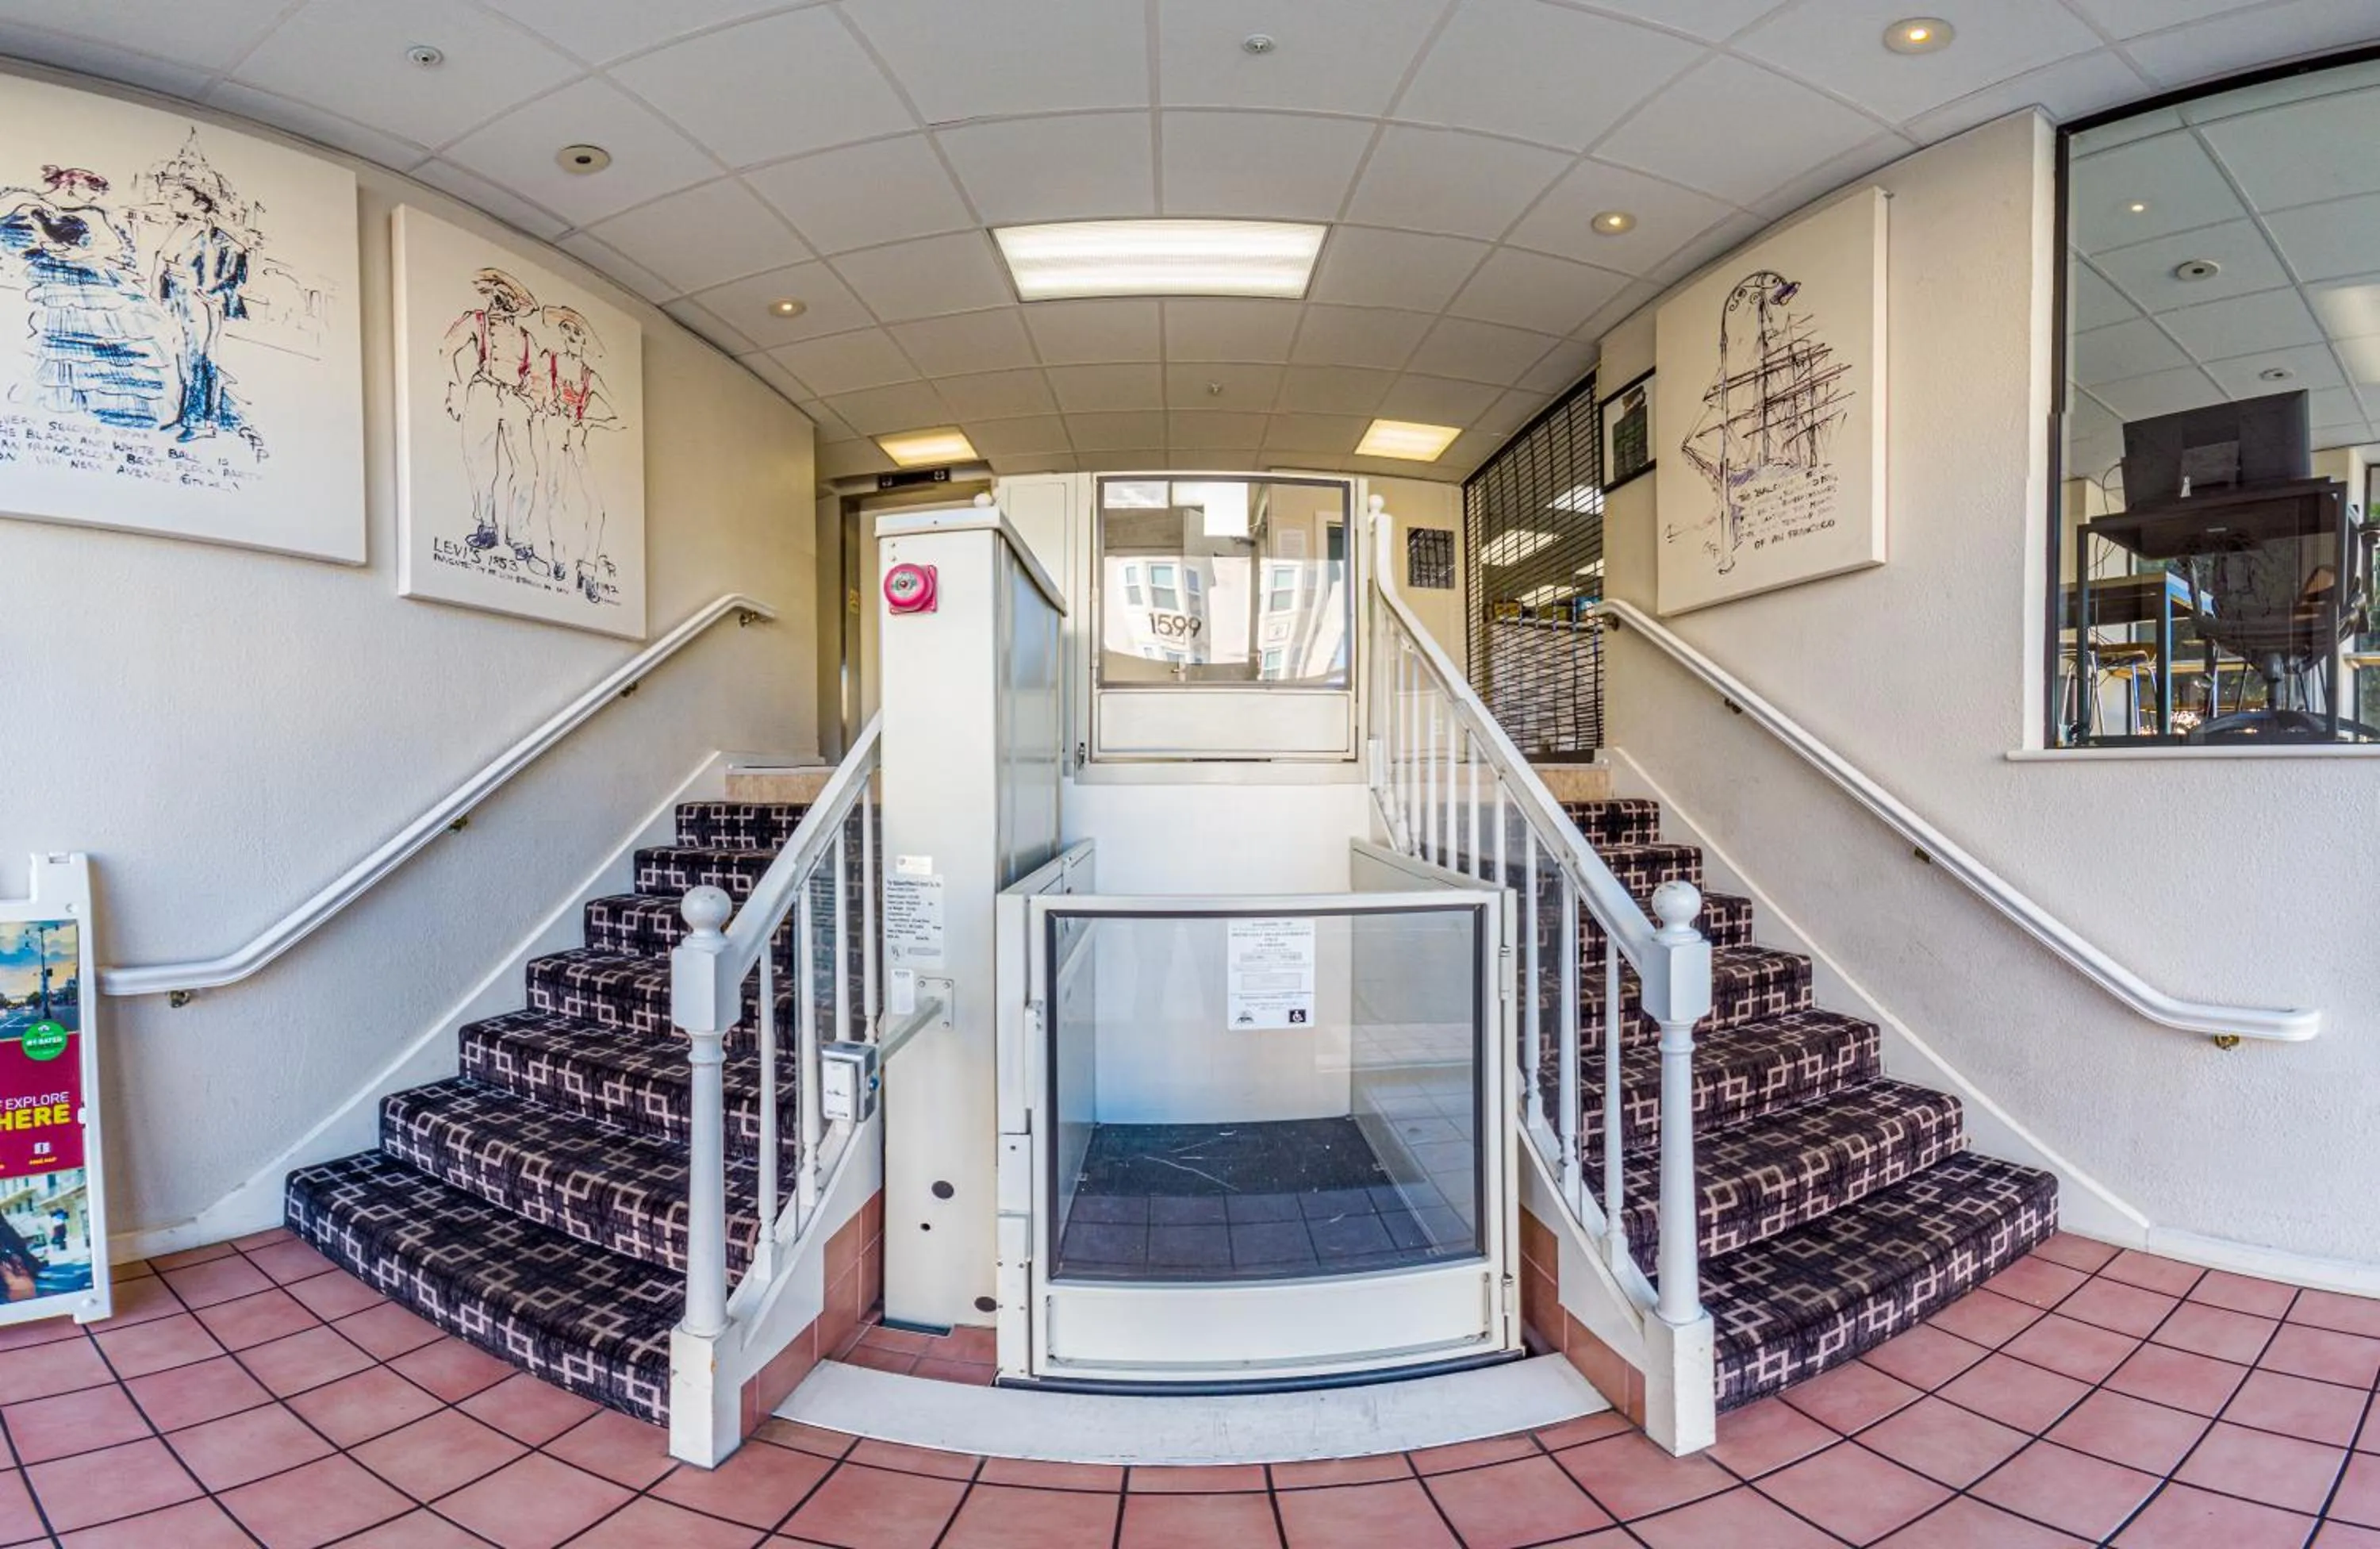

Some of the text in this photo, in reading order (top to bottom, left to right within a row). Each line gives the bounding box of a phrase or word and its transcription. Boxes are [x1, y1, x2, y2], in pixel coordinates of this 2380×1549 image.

[25, 429, 71, 442] BLACK
[113, 441, 155, 456] WHITE
[126, 453, 165, 467] BEST
[433, 536, 482, 564] LEVI'S
[1148, 613, 1201, 638] 1599
[6, 1091, 70, 1110] EXPLORE
